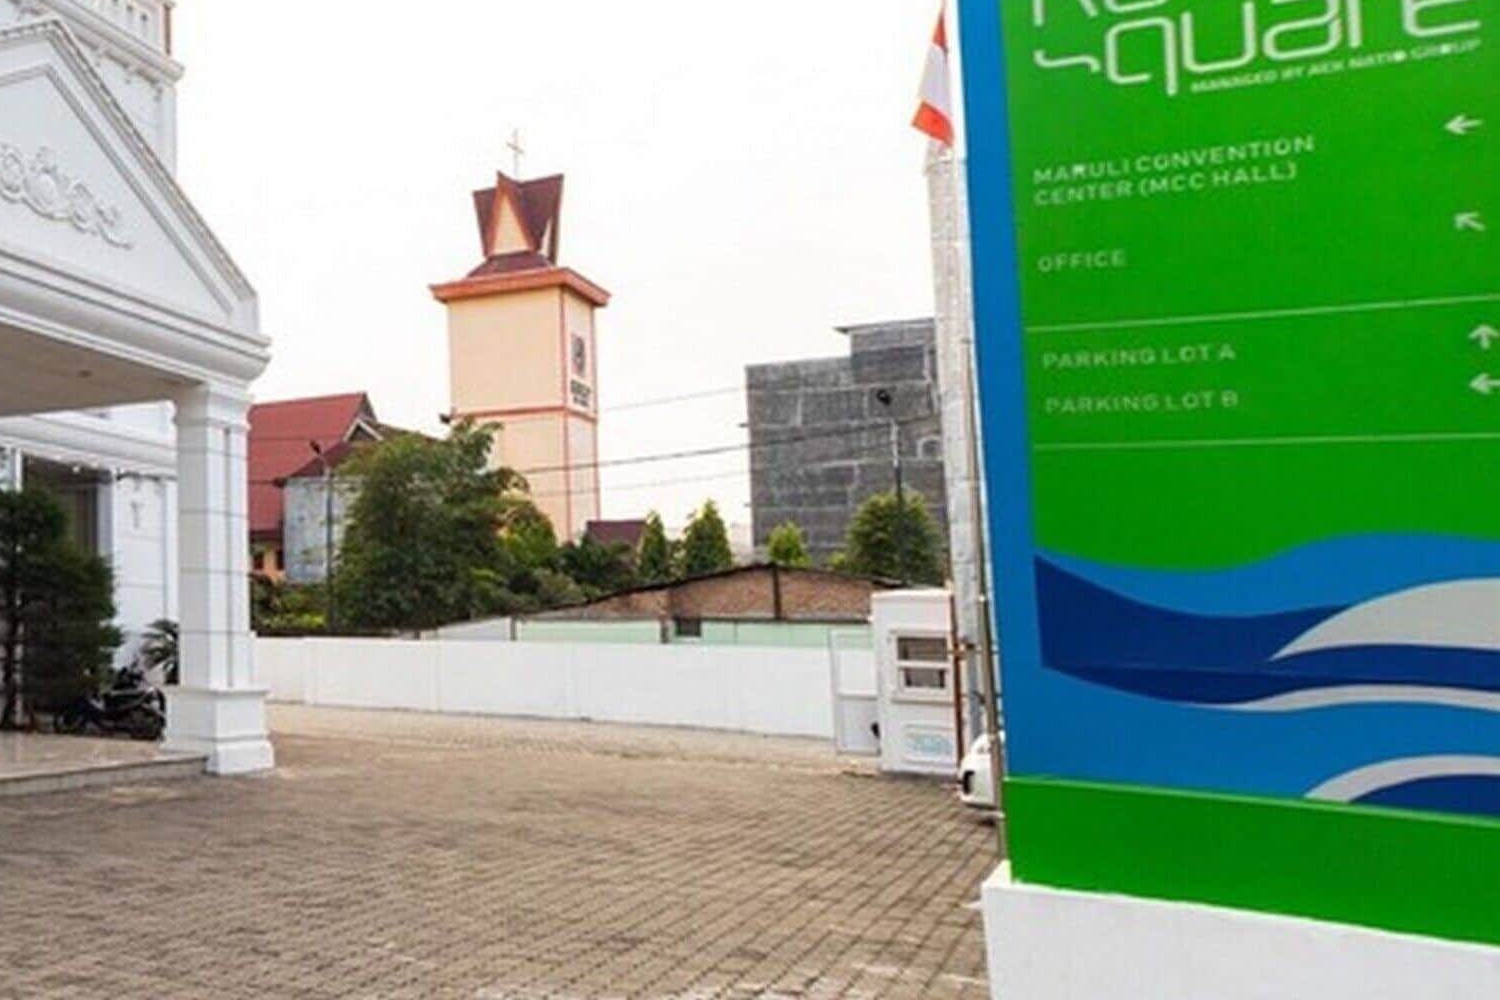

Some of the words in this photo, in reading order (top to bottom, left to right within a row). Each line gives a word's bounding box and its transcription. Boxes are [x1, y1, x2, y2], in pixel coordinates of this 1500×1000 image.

[1281, 65, 1304, 80] BY
[1410, 37, 1482, 60] GROUP
[1032, 158, 1131, 185] MARULI
[1134, 134, 1317, 172] CONVENTION
[1033, 178, 1133, 206] CENTER
[1138, 170, 1206, 197] (MCC
[1211, 160, 1299, 188] HALL)
[1037, 249, 1127, 273] OFFICE
[1042, 347, 1156, 369] PARKING
[1161, 343, 1212, 364] LOT
[1218, 343, 1236, 360] A
[1045, 393, 1159, 415] PARKING
[1166, 390, 1213, 410] LOT
[1220, 390, 1239, 408] B
